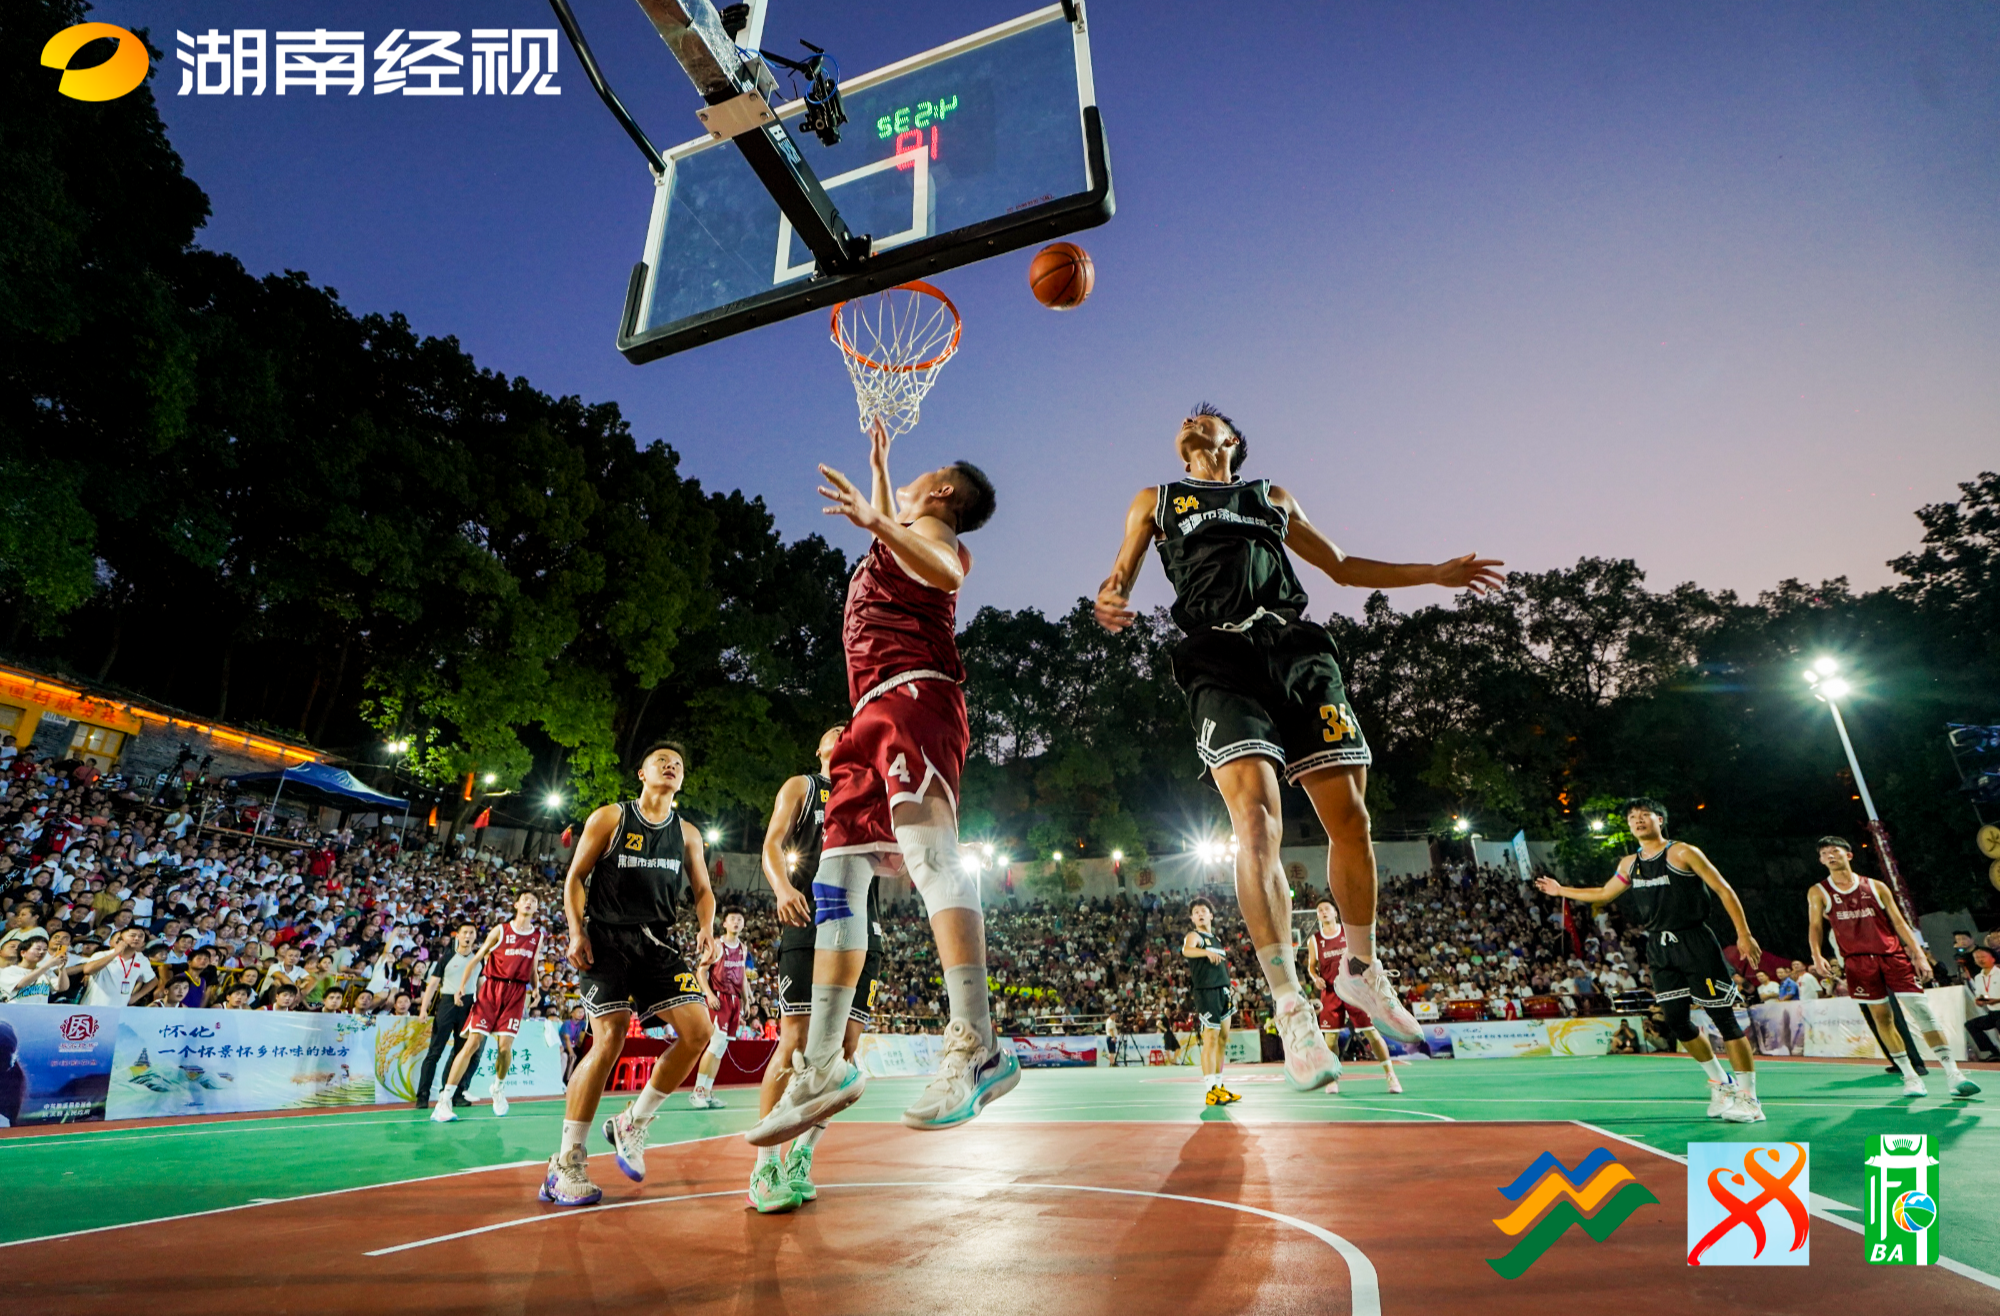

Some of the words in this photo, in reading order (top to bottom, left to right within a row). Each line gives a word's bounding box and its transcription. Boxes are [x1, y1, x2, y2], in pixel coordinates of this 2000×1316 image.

[1173, 495, 1199, 514] 34
[1319, 703, 1356, 743] 34
[888, 752, 911, 783] 4
[820, 789, 830, 803] 8
[625, 832, 644, 851] 23
[1833, 893, 1843, 904] 6
[505, 934, 517, 944] 12
[1320, 940, 1327, 948] 7
[674, 972, 701, 993] 23
[1705, 977, 1717, 997] 1
[868, 979, 878, 1007] 8
[158, 1022, 215, 1039] 怀化
[507, 1018, 520, 1031] 12
[158, 1044, 350, 1059] 一个怀景怀乡怀味的地方
